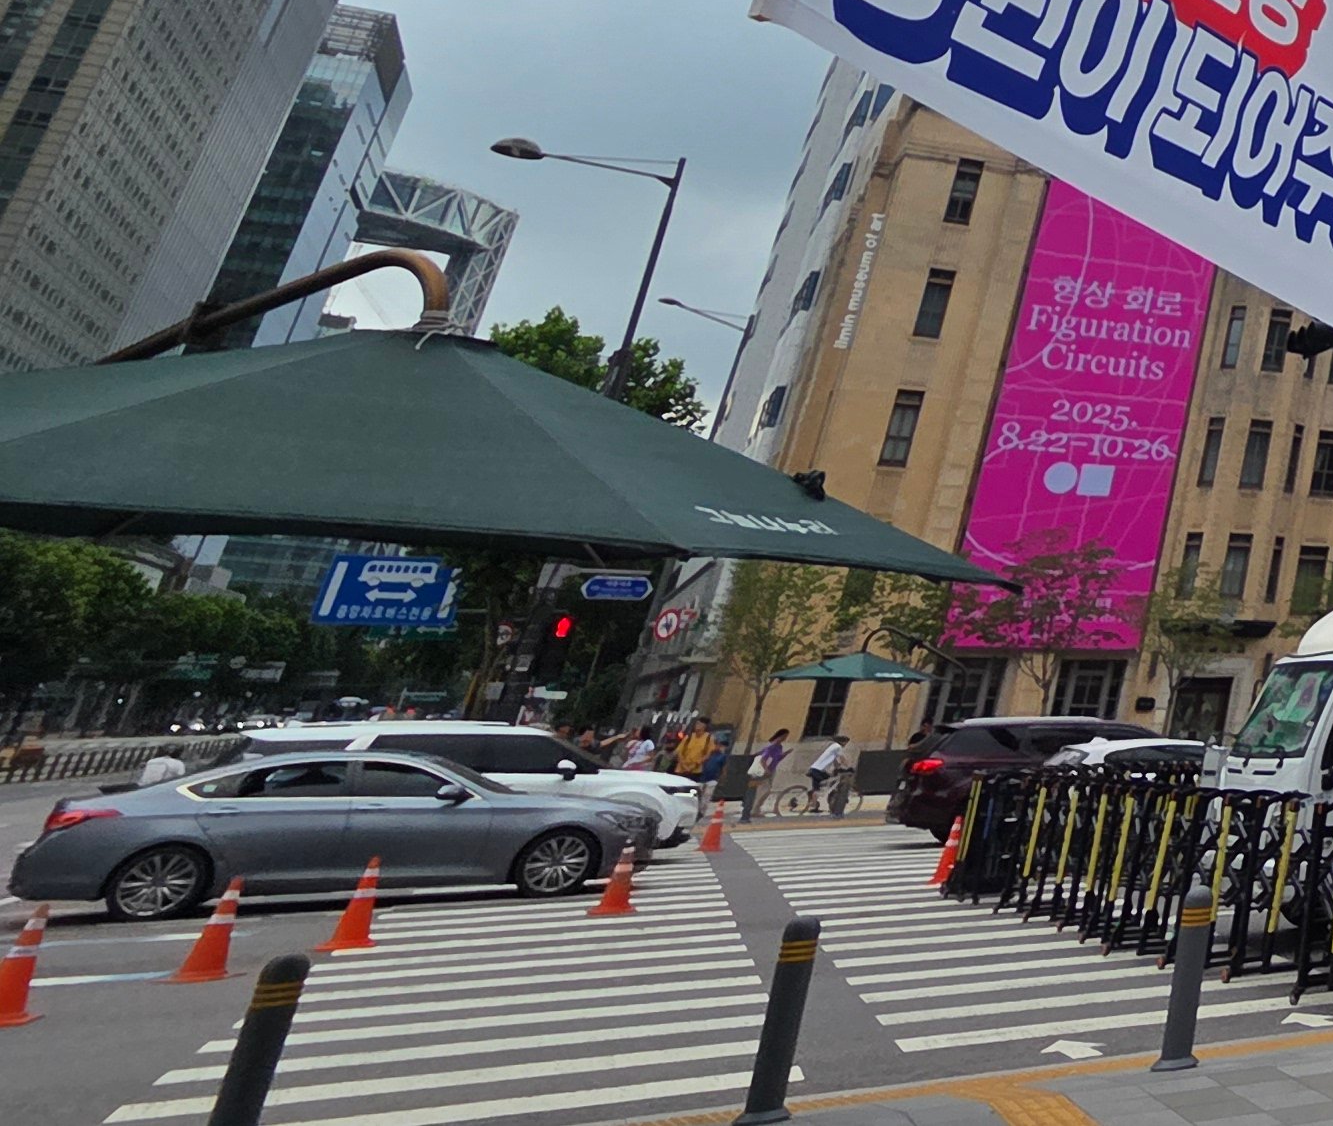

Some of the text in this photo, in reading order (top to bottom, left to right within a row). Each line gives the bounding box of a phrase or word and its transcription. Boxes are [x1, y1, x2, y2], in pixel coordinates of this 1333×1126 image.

[848, 250, 875, 312] museum
[1053, 276, 1182, 316] 형상 회로
[1026, 304, 1192, 350] Figuration
[1041, 342, 1165, 381] Circuits
[1050, 399, 1139, 432] 2025.
